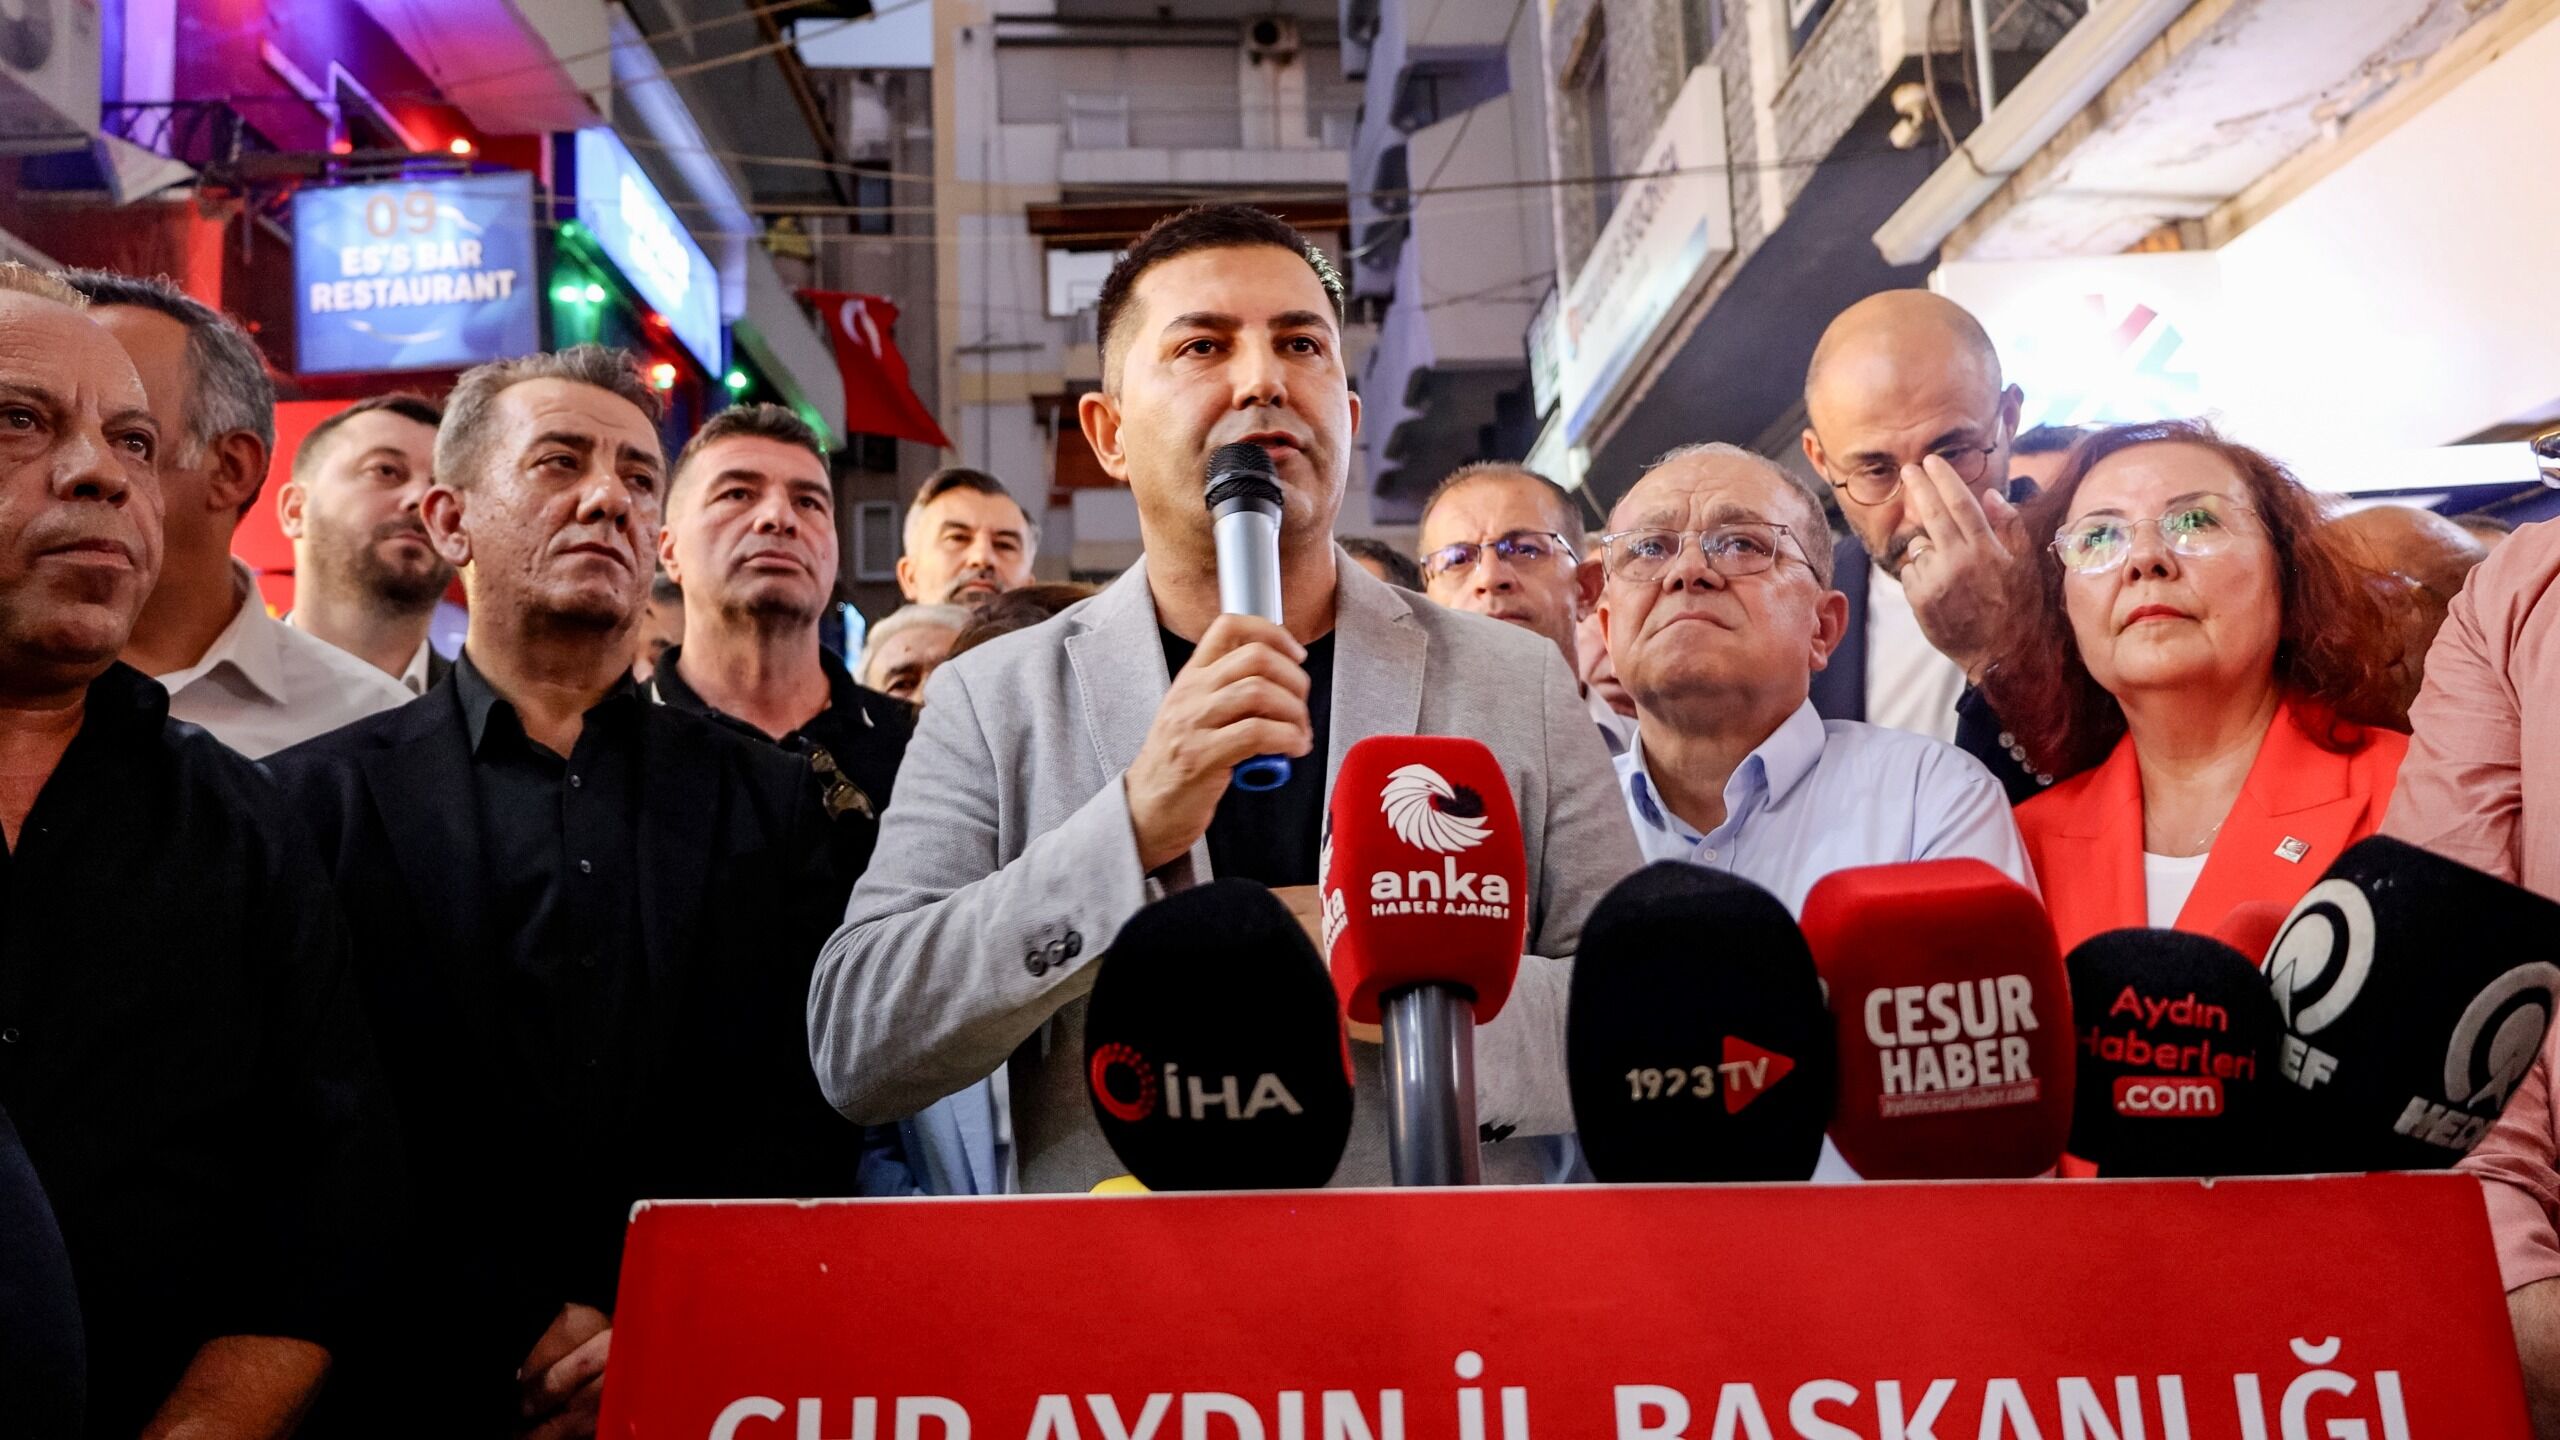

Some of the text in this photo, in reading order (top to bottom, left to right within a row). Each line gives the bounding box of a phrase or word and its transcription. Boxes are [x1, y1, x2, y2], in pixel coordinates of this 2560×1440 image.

[365, 189, 438, 239] 09
[416, 238, 483, 271] BAR
[309, 269, 517, 313] RESTAURANT
[1370, 855, 1510, 905] anka
[1371, 901, 1510, 920] HABER AJANSI
[1864, 974, 2040, 1048] CESUR
[1163, 1062, 1304, 1120] İHA
[1879, 1036, 2034, 1097] HABER
[2117, 1083, 2216, 1112] .com
